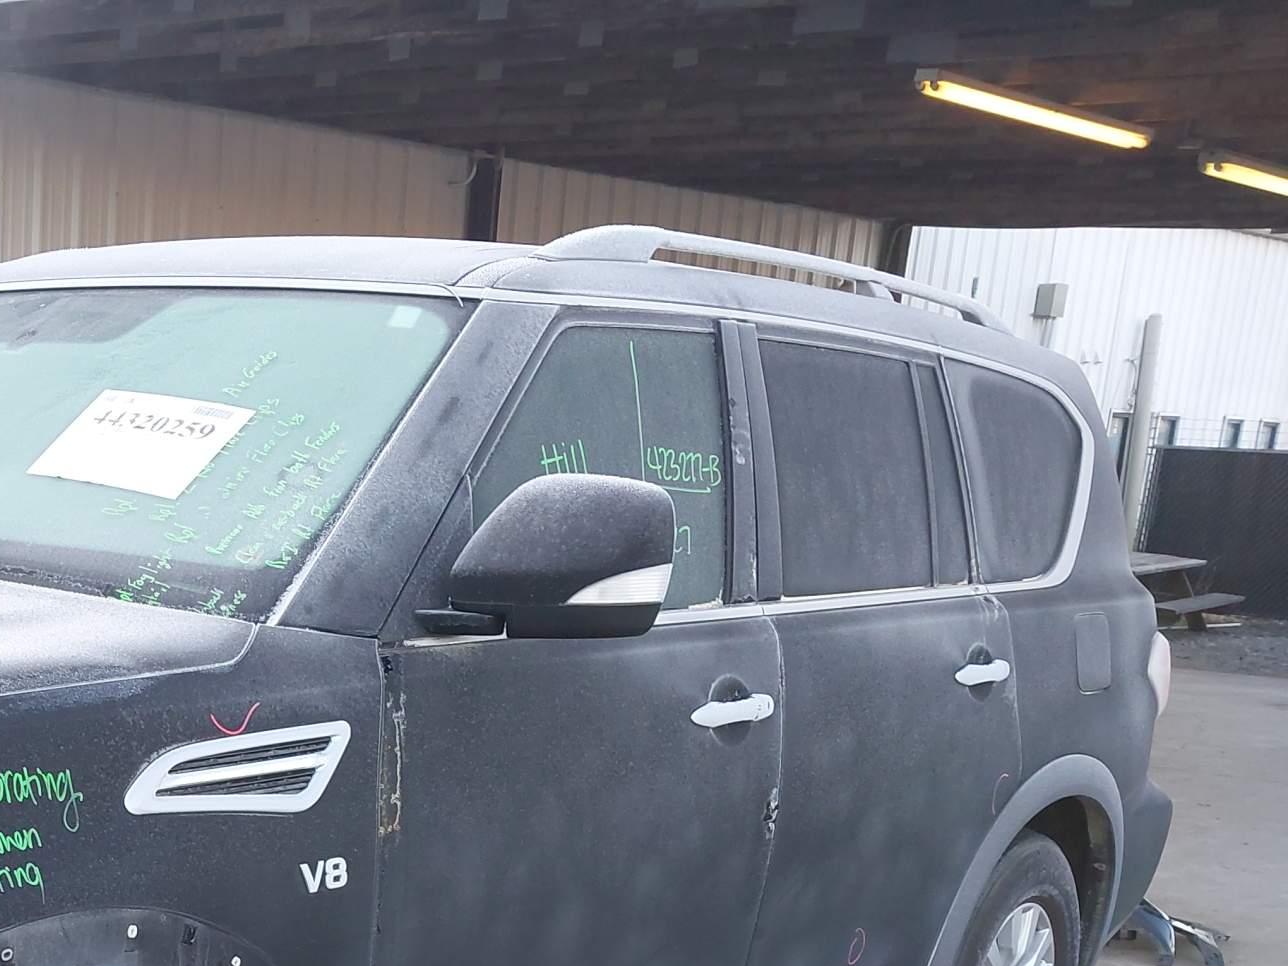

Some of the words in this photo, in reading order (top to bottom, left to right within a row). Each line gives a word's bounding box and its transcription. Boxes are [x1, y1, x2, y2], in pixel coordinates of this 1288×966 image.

[93, 409, 216, 440] 44320259
[541, 439, 588, 474] Hill
[300, 857, 348, 894] V8
